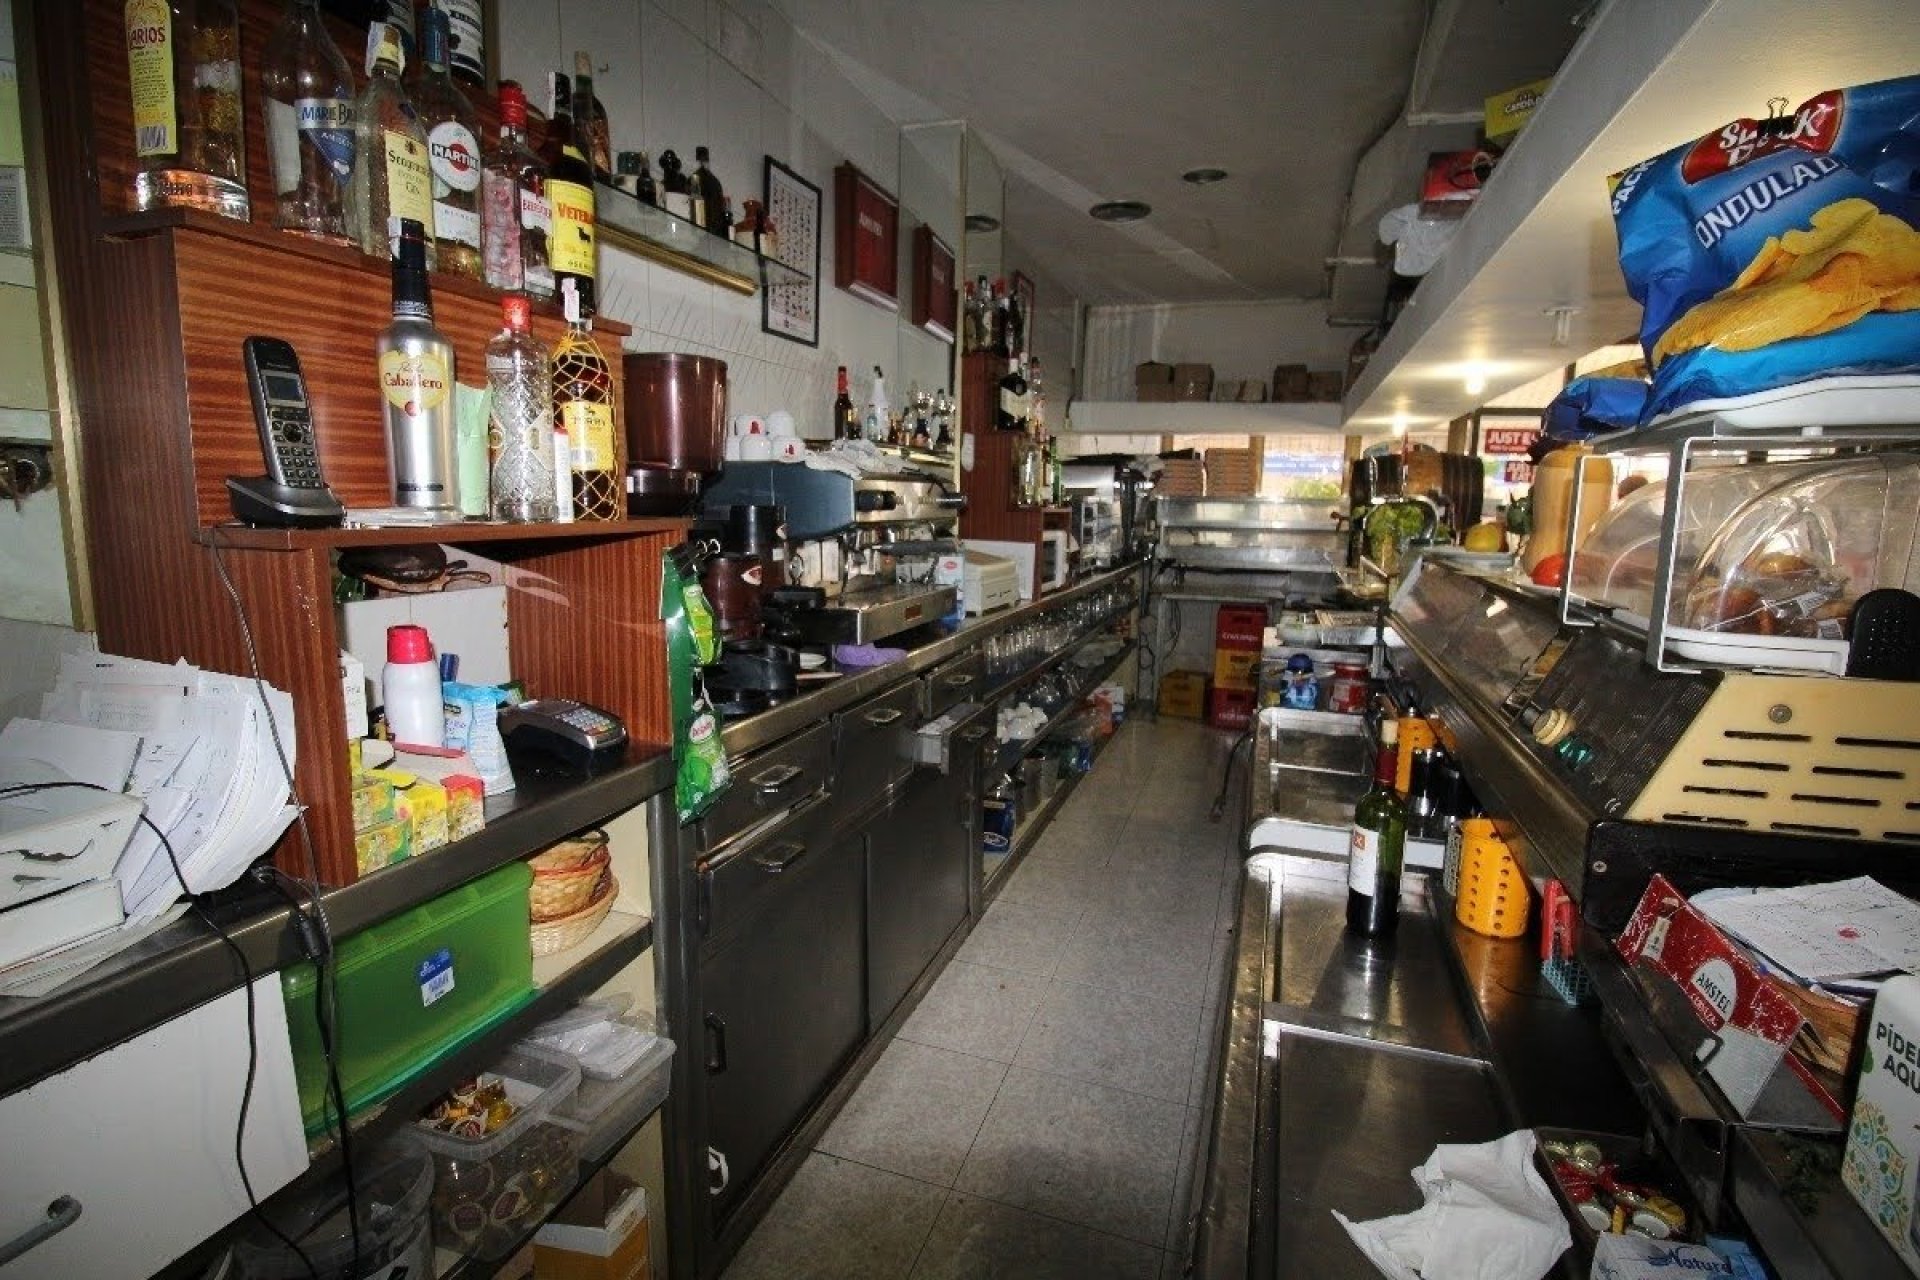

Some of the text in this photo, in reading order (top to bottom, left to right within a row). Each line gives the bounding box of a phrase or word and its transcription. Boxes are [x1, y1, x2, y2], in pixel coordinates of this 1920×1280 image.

[302, 106, 337, 120] MARIE
[1487, 431, 1520, 445] JUST
[1695, 973, 1732, 1014] AMSTEL
